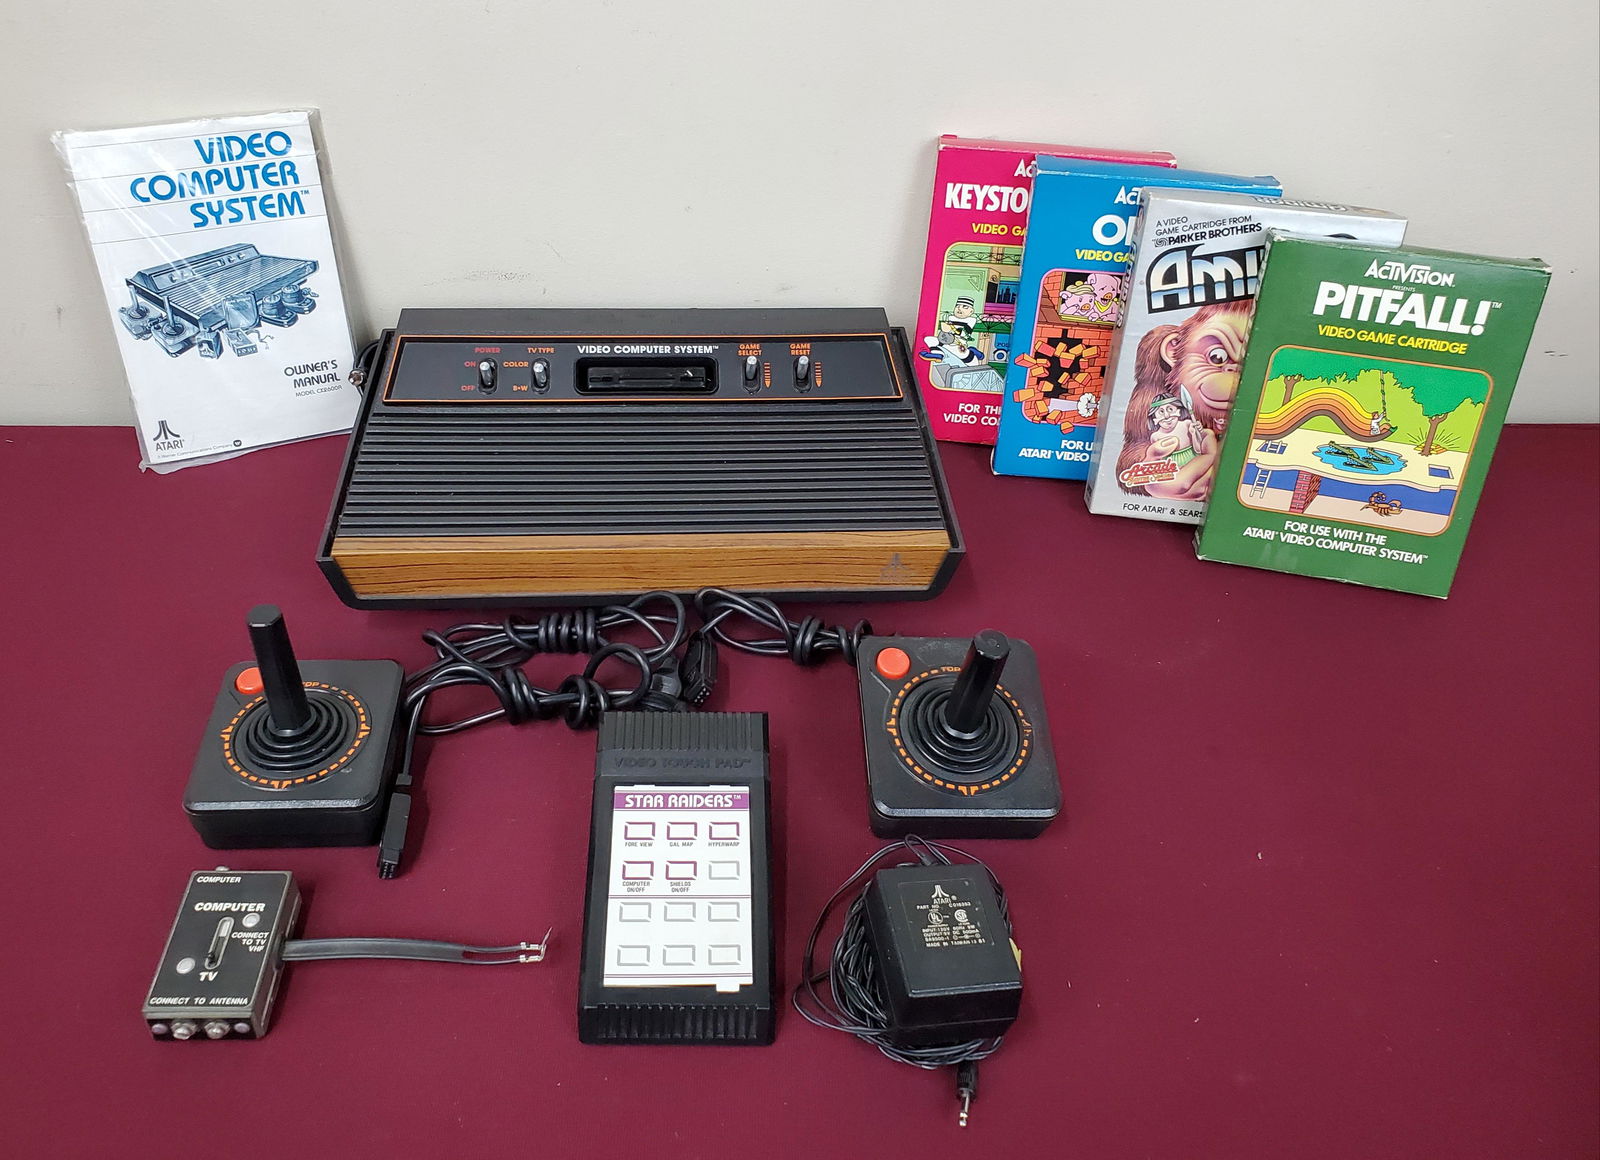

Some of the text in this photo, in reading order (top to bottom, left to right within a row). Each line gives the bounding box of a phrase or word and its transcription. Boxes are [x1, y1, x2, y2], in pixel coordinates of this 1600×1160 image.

[194, 130, 292, 165] VIDEO
[130, 160, 300, 203] COMPUTER
[945, 182, 1029, 213] KEYSTO
[971, 222, 1008, 236] VIDEO
[1155, 214, 1252, 236] GAME CARTRIDGE FROM
[1156, 216, 1188, 228] A VIDEO
[1168, 222, 1262, 245] PARKER BROTHERS
[1075, 248, 1113, 262] VIDEO
[1363, 258, 1455, 287] ACTIVISION
[1317, 324, 1468, 355] VIDEO GAME CARTRIDGE
[577, 345, 611, 354] VIDEO
[613, 345, 671, 354] COMPUTER
[284, 359, 338, 377] OWNER'S
[293, 372, 341, 389] MANUAL
[296, 389, 316, 397] MODEL
[958, 403, 980, 414] FOR
[943, 413, 977, 425] VIDEO
[1060, 439, 1084, 450] FOR
[1055, 450, 1090, 462] VIDEO
[1122, 502, 1140, 512] FOR
[1284, 520, 1387, 546] FOR USE WITH THE
[1279, 531, 1315, 547] VIDEO
[1315, 537, 1376, 556] COMPUTER
[614, 757, 657, 768] VIDEO
[662, 757, 711, 768] TOUCH
[624, 794, 664, 808] STAR
[194, 902, 266, 912] COMPUTER
[231, 931, 270, 939] CONNECT
[199, 971, 218, 982] TV
[150, 997, 249, 1005] CONNECT TO ANTENNA
